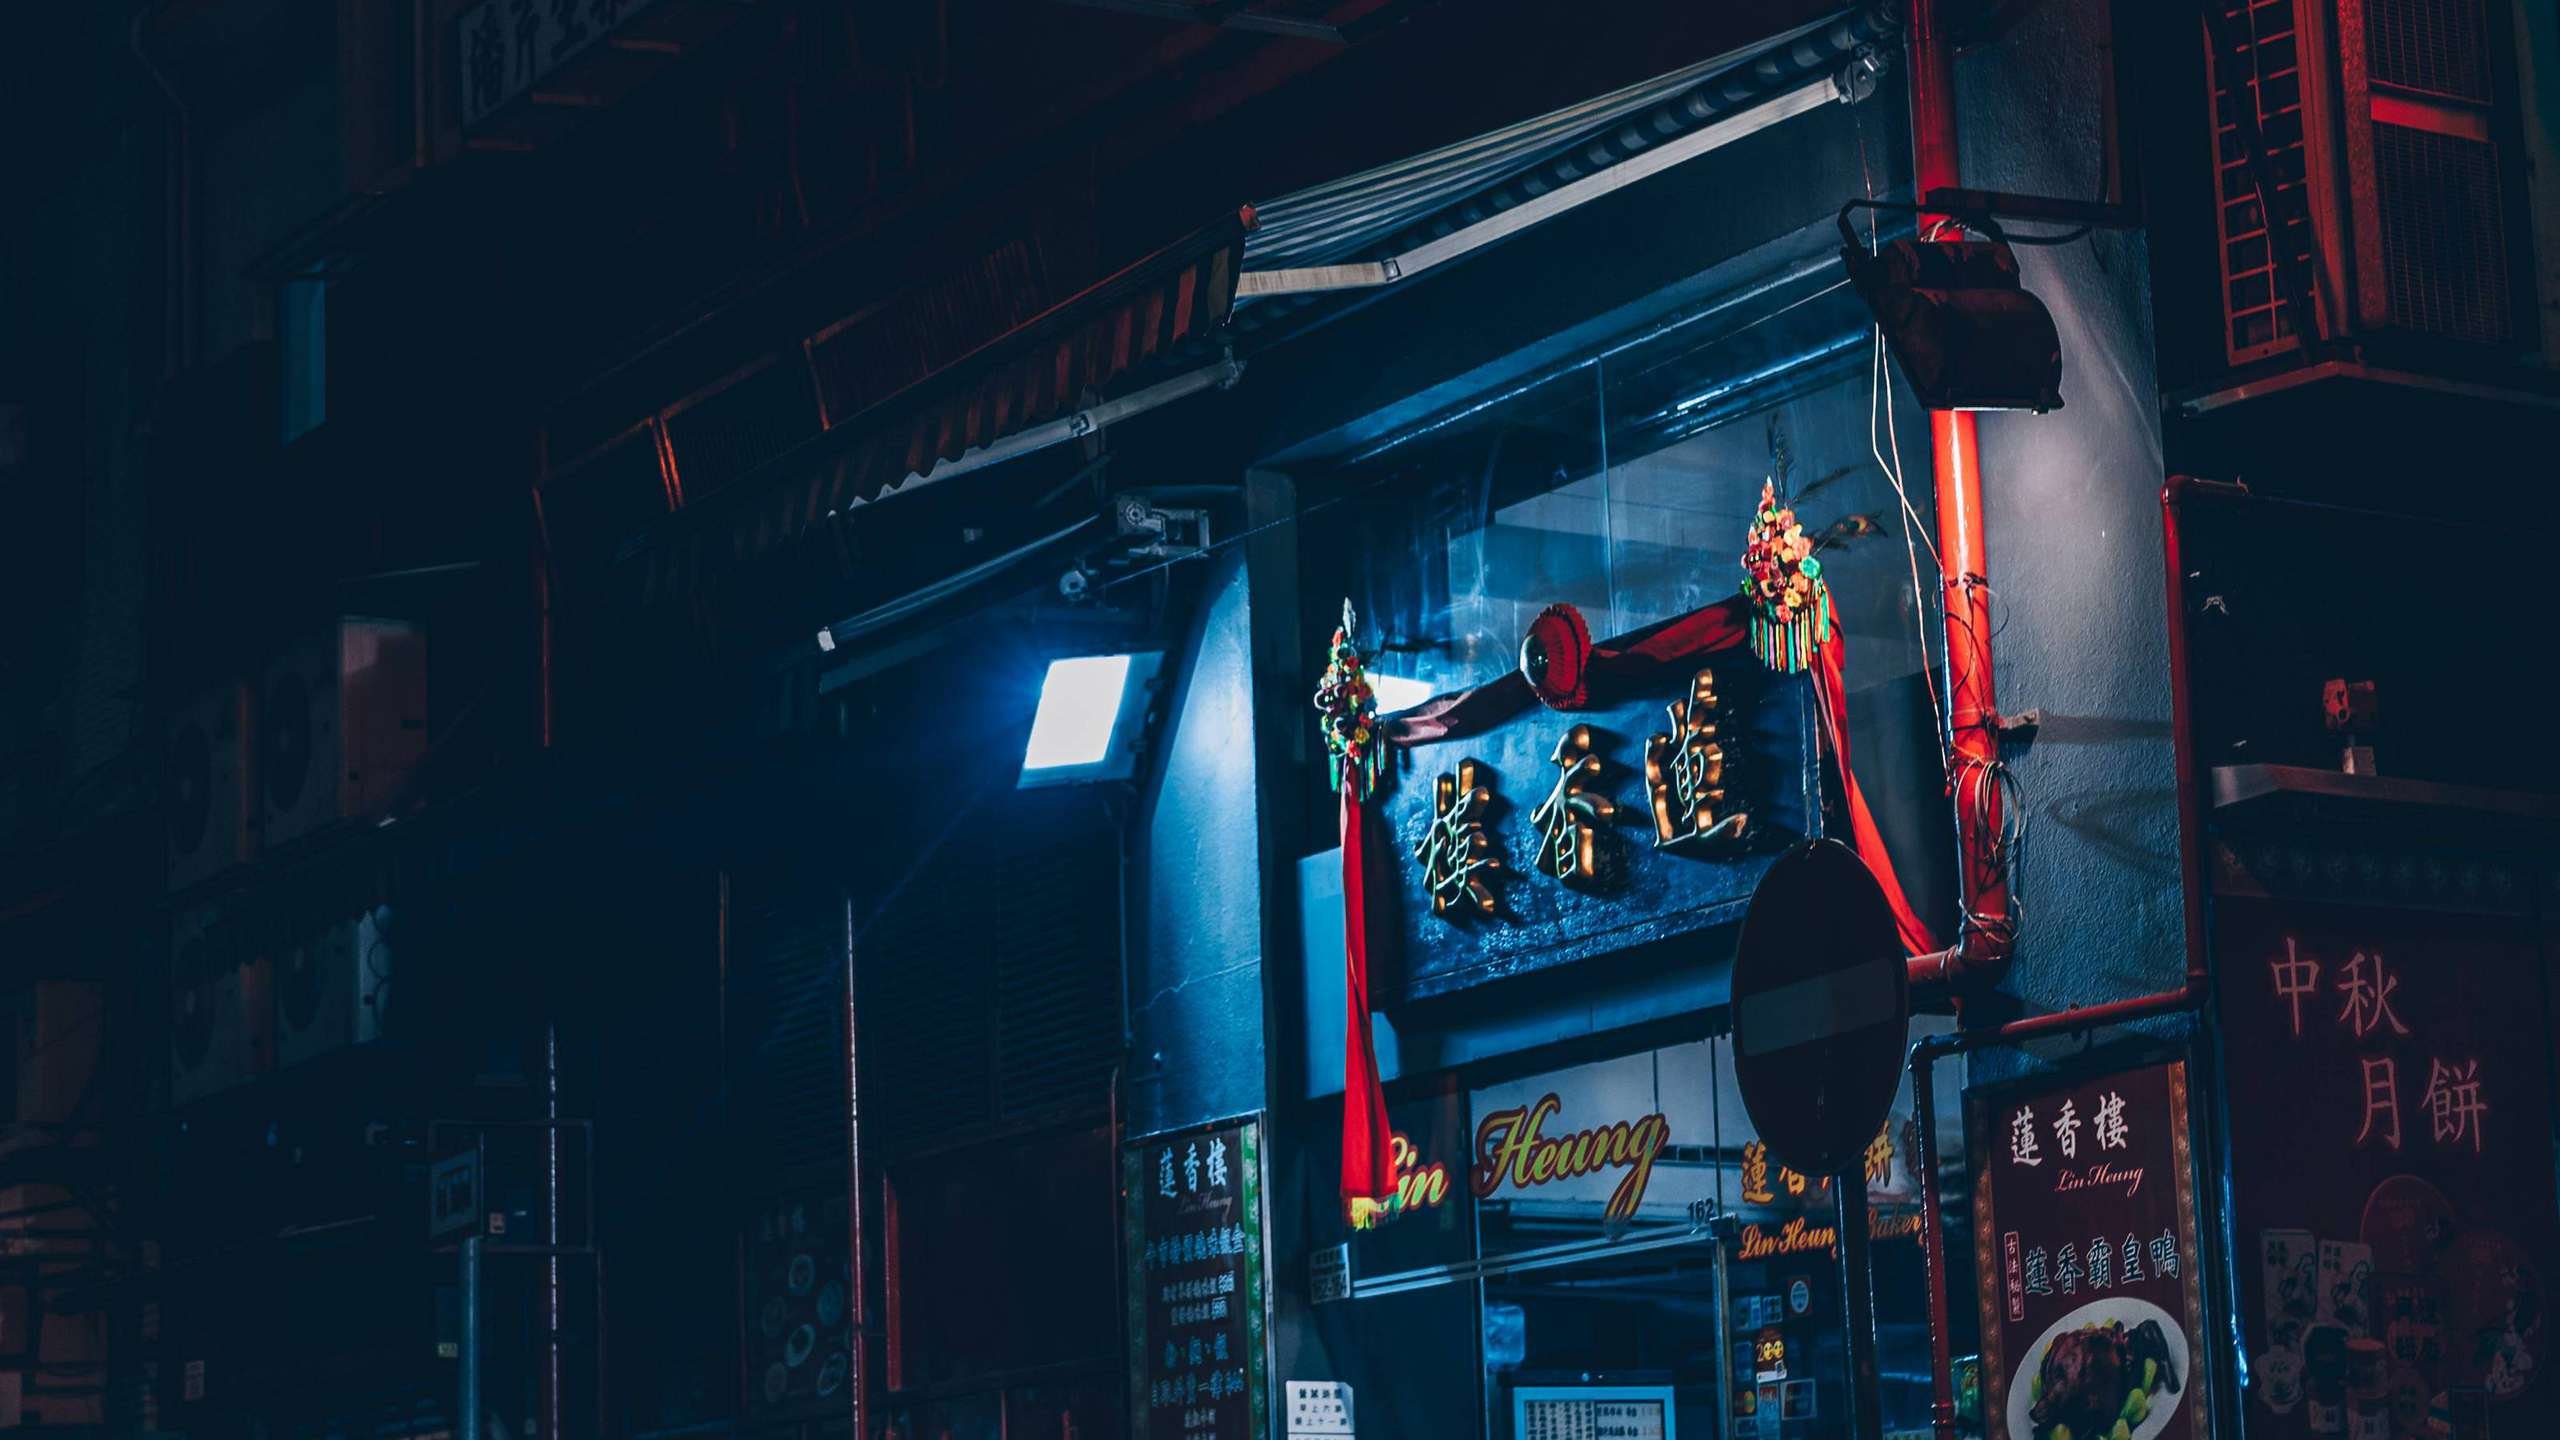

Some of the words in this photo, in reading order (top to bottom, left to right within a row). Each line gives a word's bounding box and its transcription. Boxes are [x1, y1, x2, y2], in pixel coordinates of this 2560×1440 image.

[2270, 937, 2411, 1037] 中秋
[2011, 1091, 2129, 1167] 蓮香樓
[2356, 1056, 2488, 1153] 月餅
[1470, 1092, 1669, 1236] Heung
[2054, 1168, 2085, 1192] Lin
[2087, 1163, 2144, 1198] Heung
[1686, 1198, 1715, 1225] 162
[1737, 1223, 1777, 1261] Lin
[2025, 1228, 2181, 1296] 蓮香霸皇鴨
